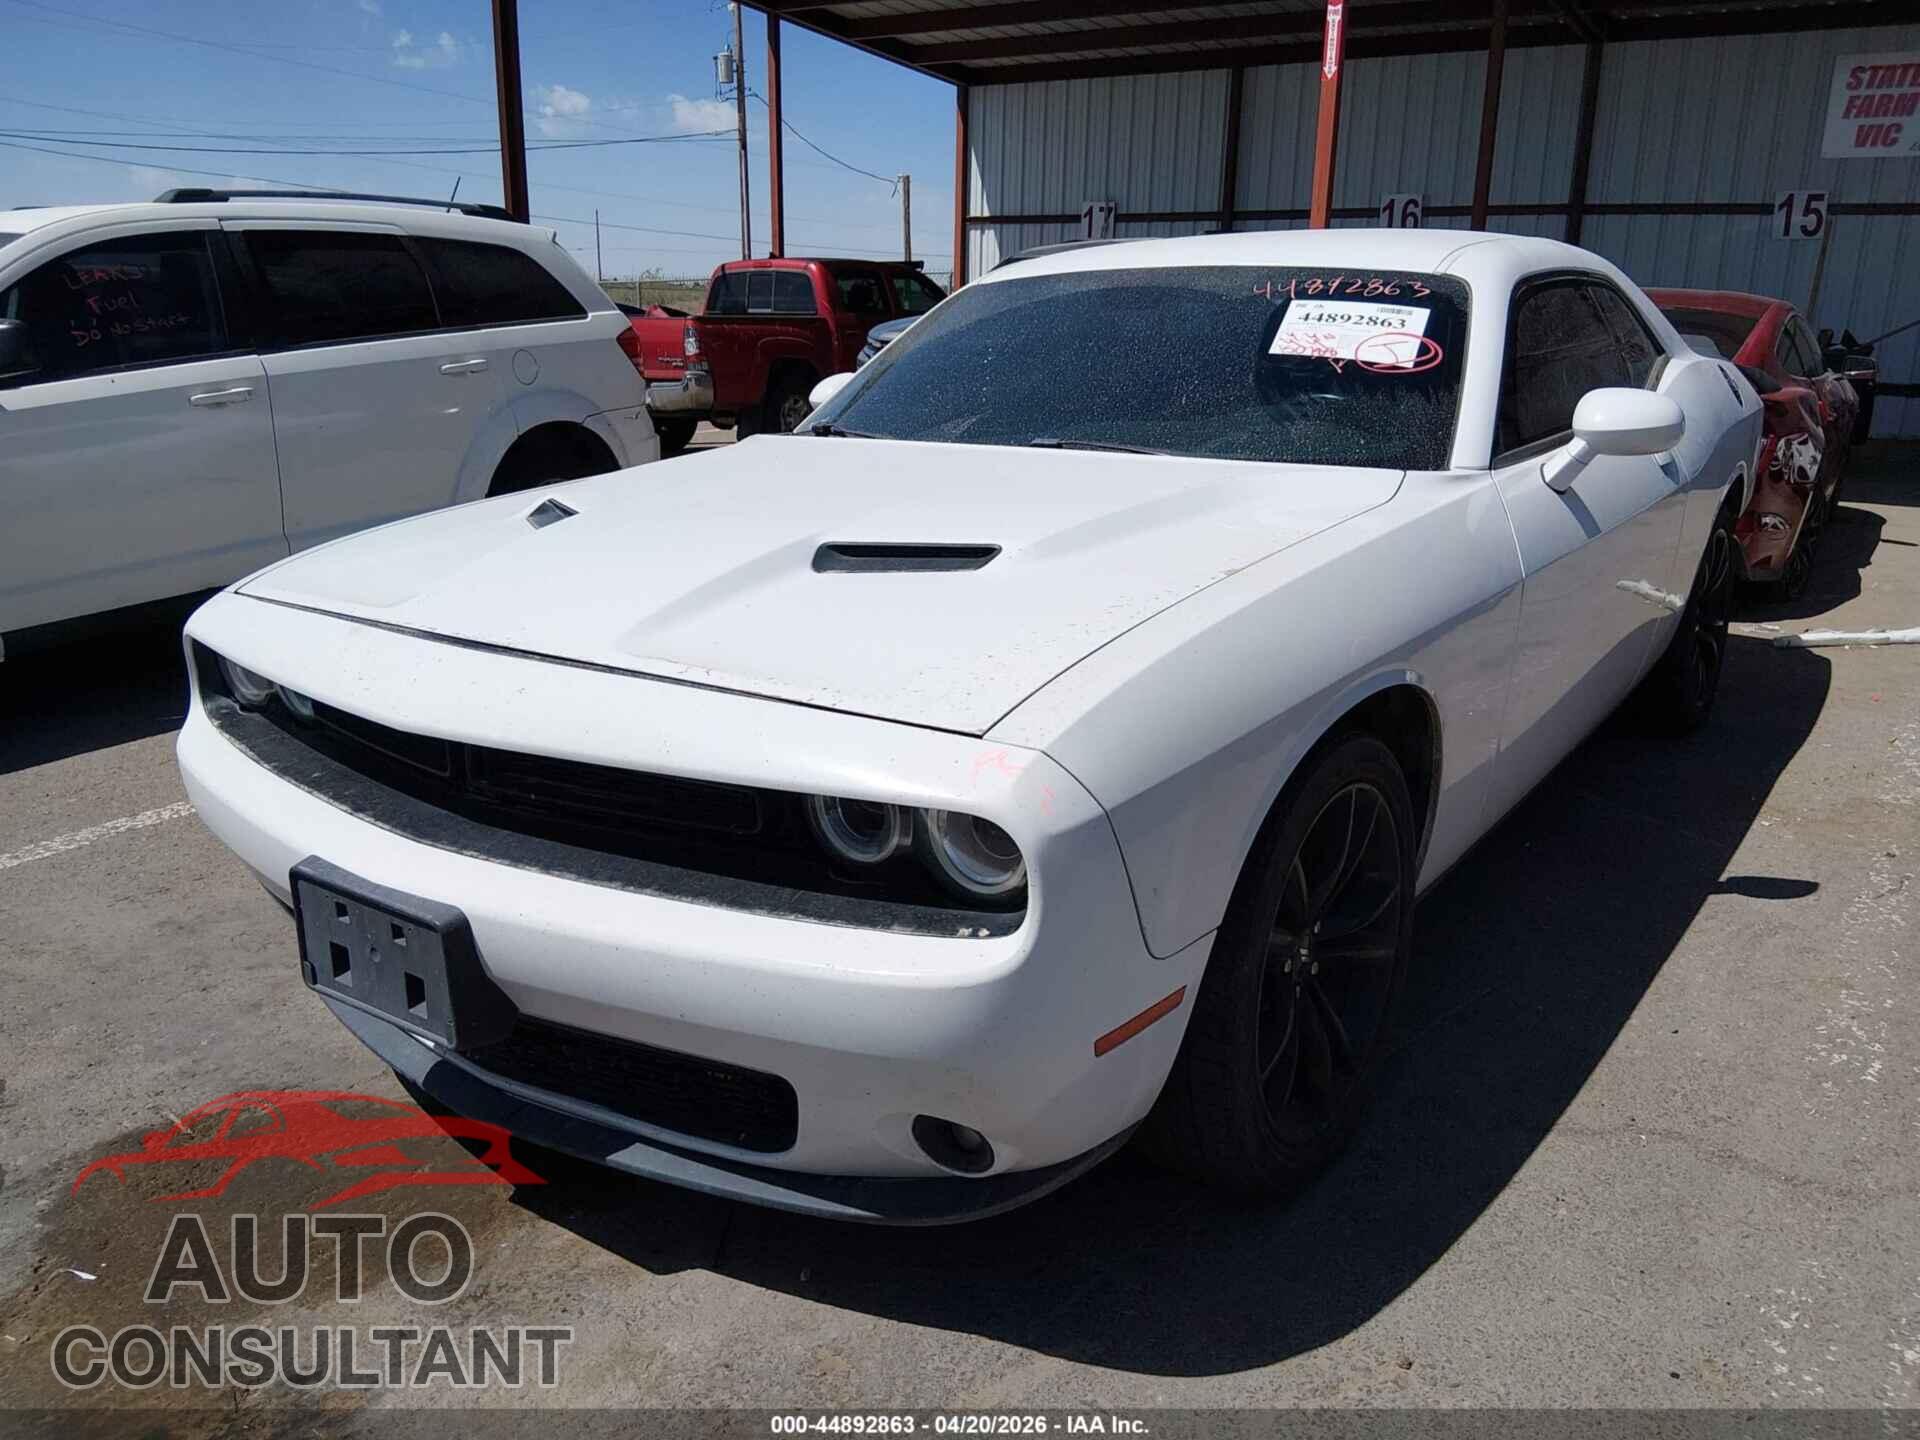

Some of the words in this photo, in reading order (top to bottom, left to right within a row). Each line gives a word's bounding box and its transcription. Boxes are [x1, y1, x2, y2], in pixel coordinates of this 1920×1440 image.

[1841, 92, 1920, 120] FARM
[1855, 123, 1904, 148] VIC
[1083, 205, 1114, 239] 17
[1382, 198, 1420, 229] 16
[1777, 193, 1824, 237] 15
[1253, 276, 1432, 300] 44892863
[1297, 311, 1407, 330] 44892863
